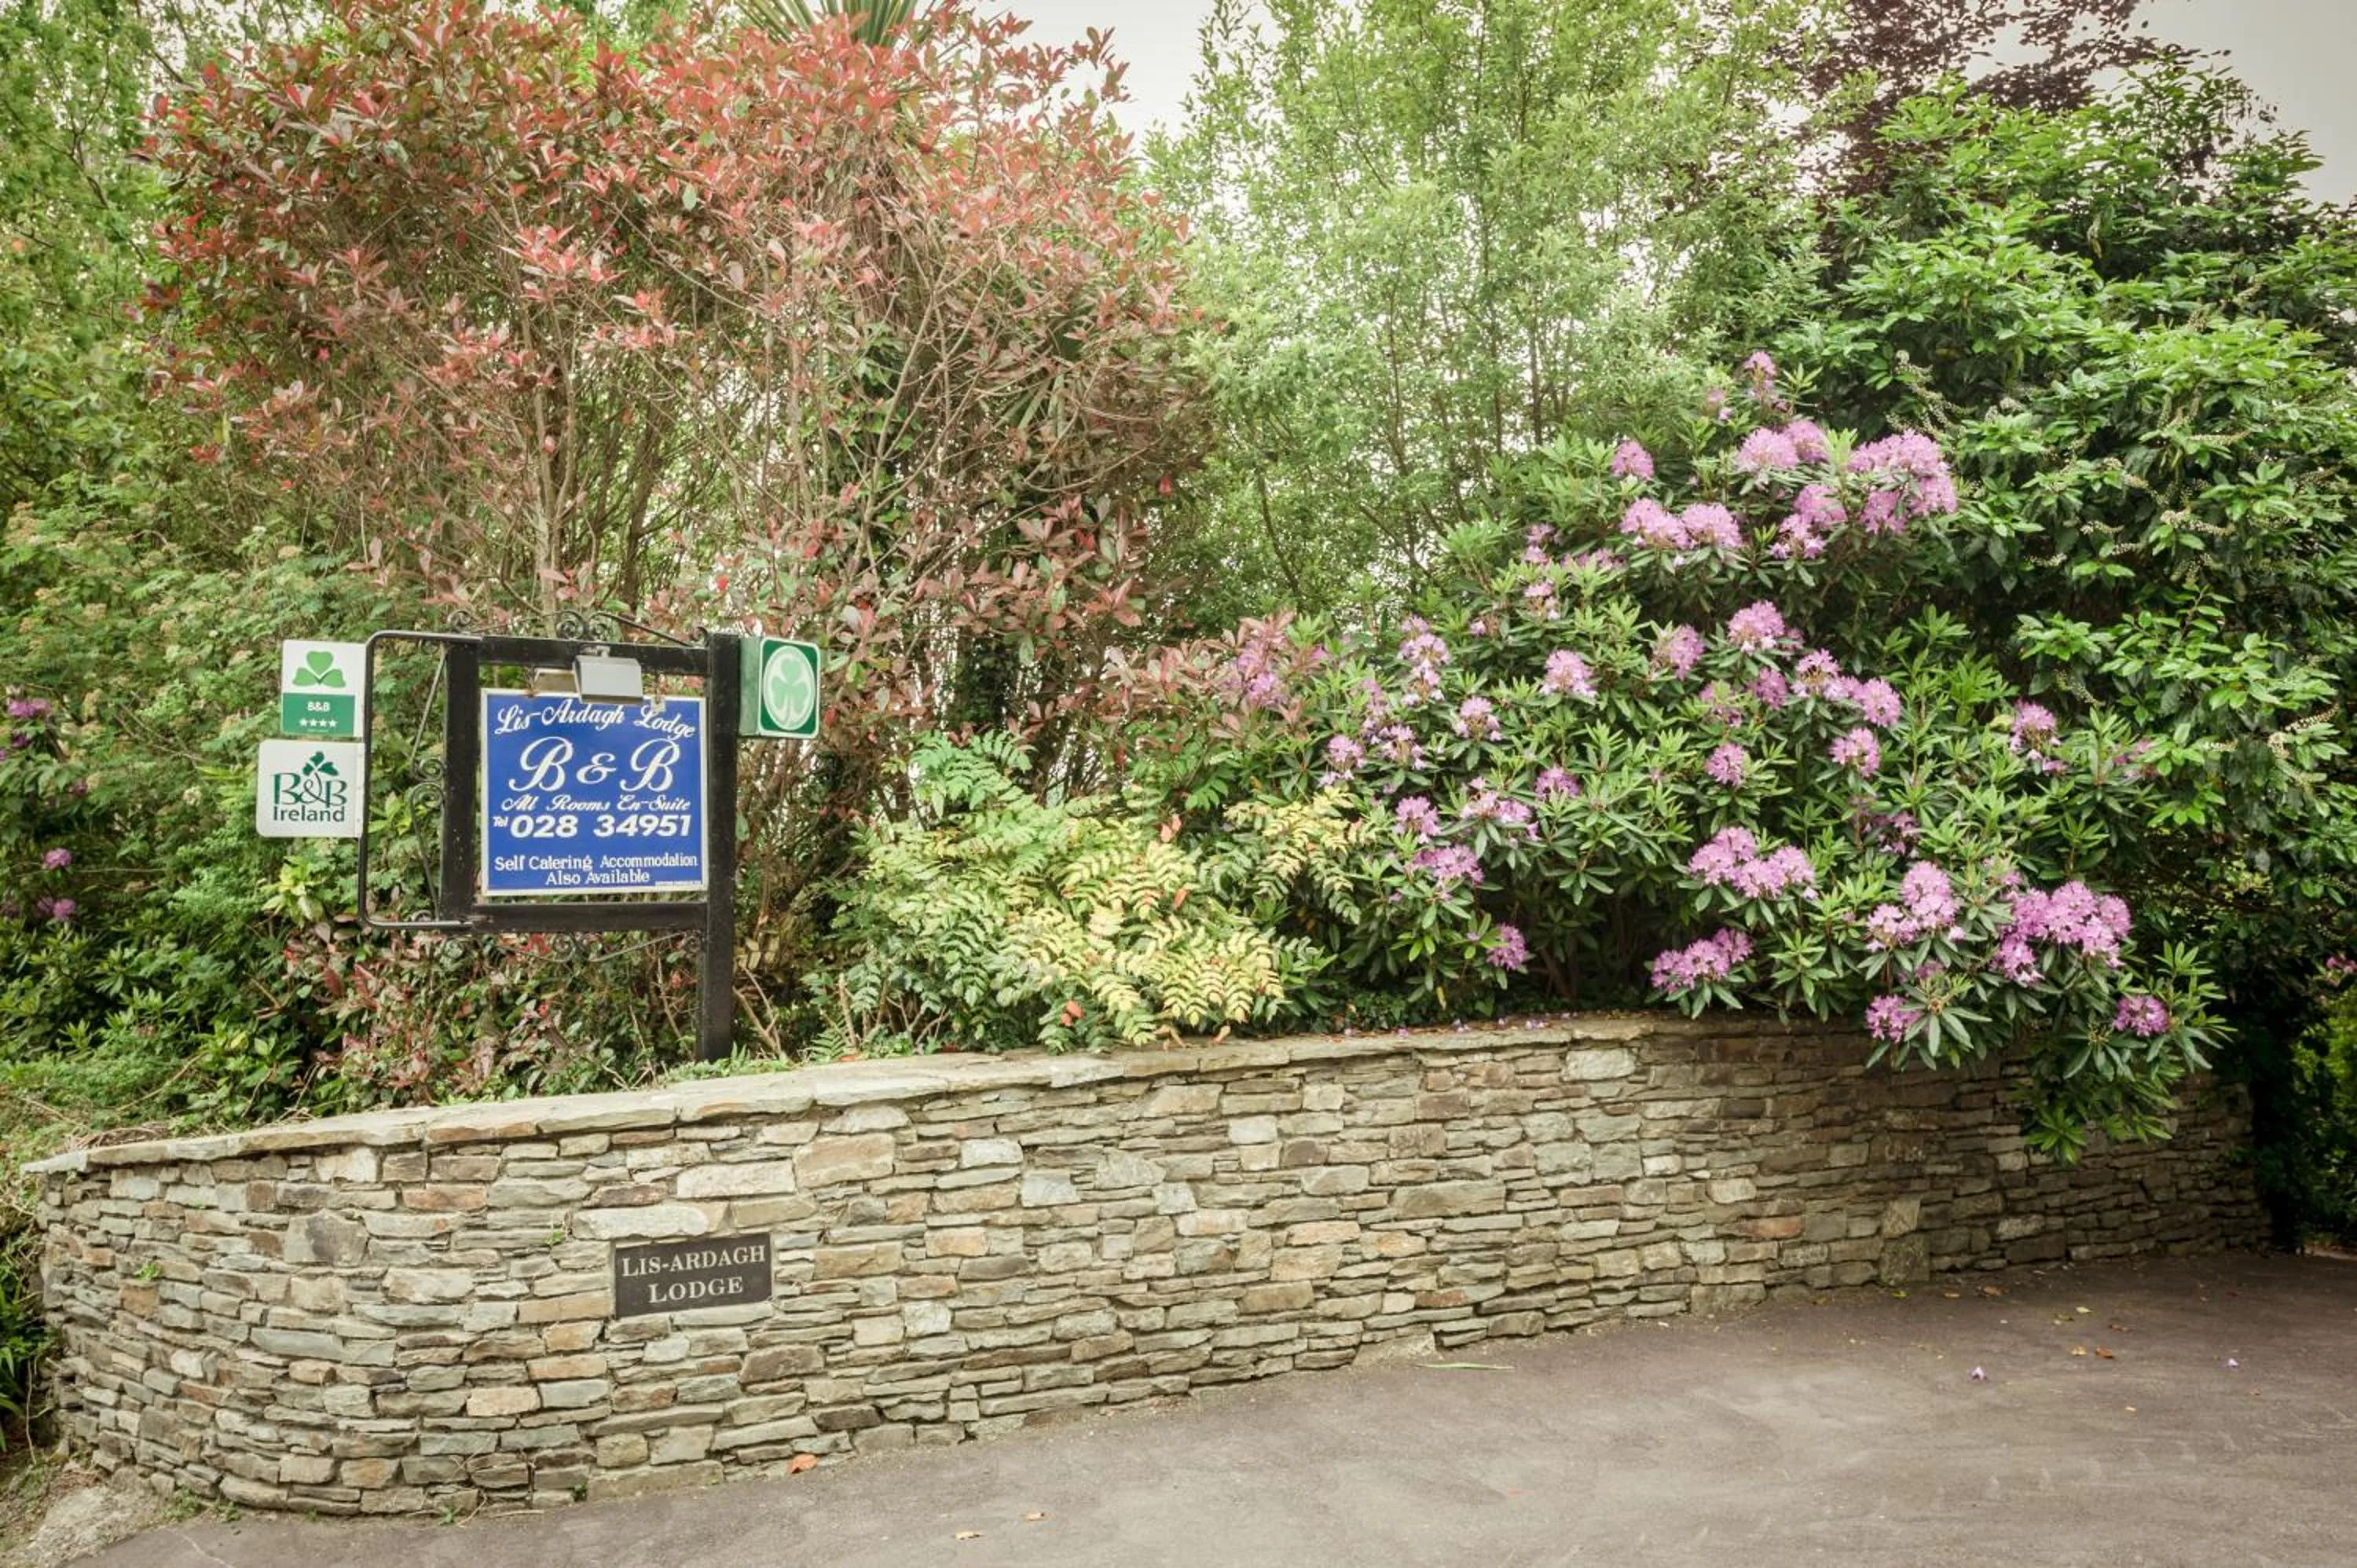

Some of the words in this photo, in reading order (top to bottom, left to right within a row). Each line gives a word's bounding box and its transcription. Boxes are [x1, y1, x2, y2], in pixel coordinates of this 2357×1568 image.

[307, 702, 330, 712] B&B
[634, 705, 696, 740] Lodge
[508, 736, 574, 791] B
[576, 752, 617, 784] &
[619, 738, 681, 791] B
[272, 772, 348, 808] B&B
[273, 806, 345, 822] Ireland
[501, 795, 538, 811] All
[546, 794, 610, 811] Rooms
[617, 794, 691, 811] En-Suite
[492, 816, 509, 827] Tel
[510, 815, 579, 838] 028
[593, 815, 692, 837] 34951
[494, 855, 526, 871] Self
[529, 855, 593, 872] Catering
[599, 853, 698, 870] Accommodation
[545, 870, 581, 886] Also
[585, 868, 651, 885] Available
[621, 1245, 767, 1277] LIS-ARDAGH
[647, 1277, 744, 1304] LODGE
